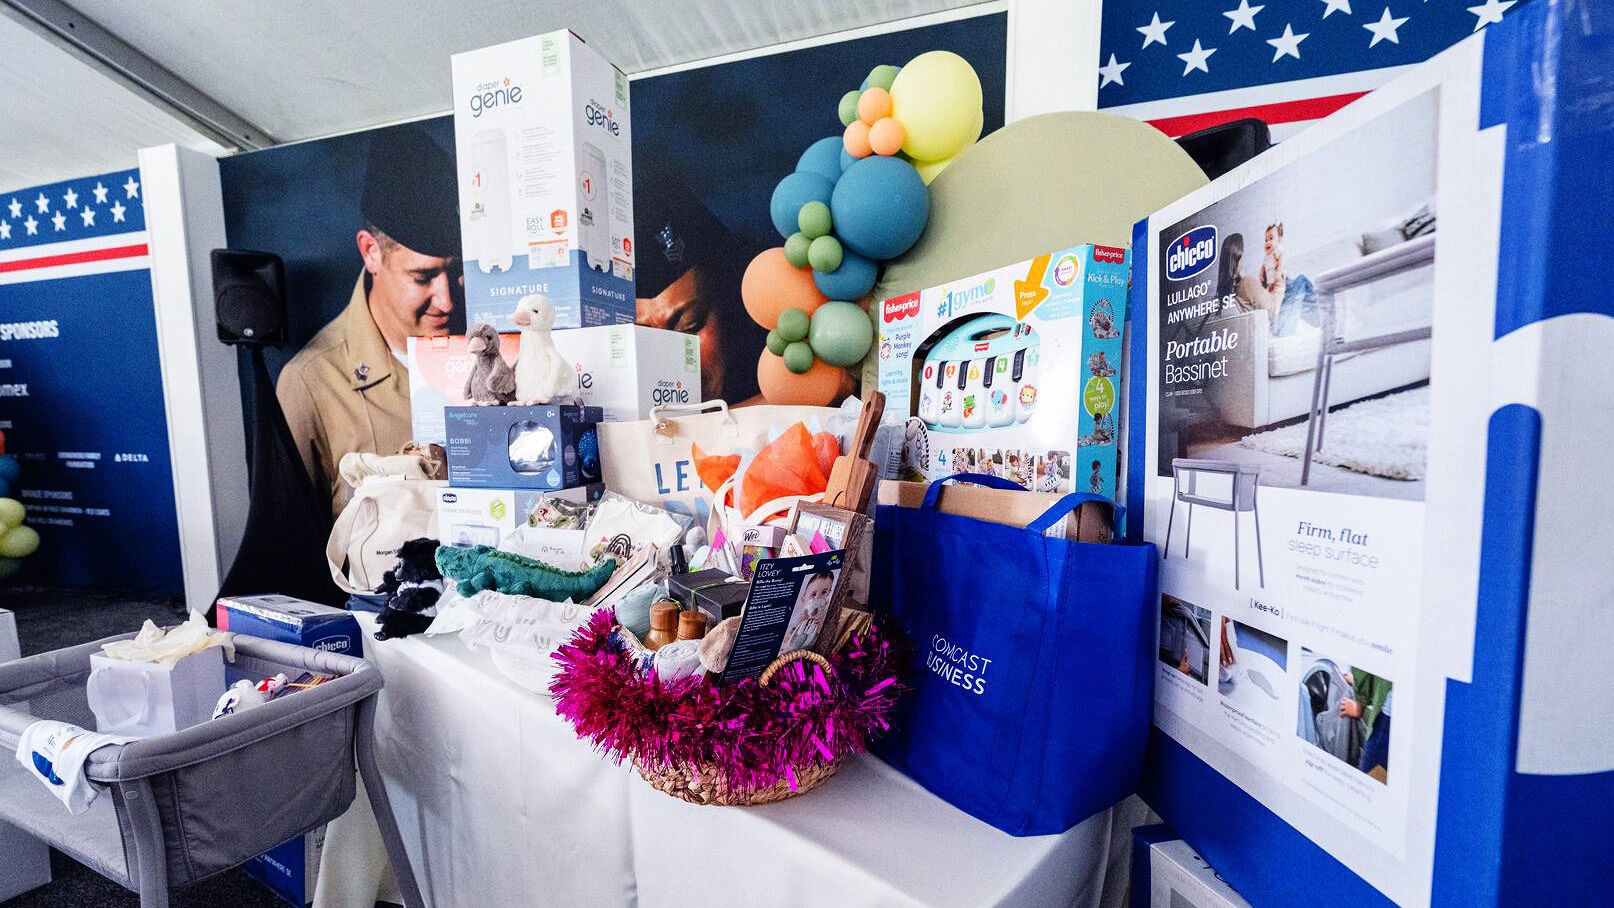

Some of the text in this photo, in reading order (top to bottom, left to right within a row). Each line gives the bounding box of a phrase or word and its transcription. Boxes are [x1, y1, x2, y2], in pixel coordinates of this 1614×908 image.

[470, 86, 523, 118] genie
[585, 104, 620, 137] genie
[1095, 248, 1123, 259] fisher-price
[1169, 236, 1214, 273] chicco
[490, 283, 549, 297] SIGNATURE
[1087, 273, 1104, 283] Kick
[1110, 275, 1125, 288] Play
[591, 285, 626, 301] SIGNATURE
[885, 299, 919, 314] fisher-price
[1167, 293, 1237, 325] ANYWHERE SE
[0, 319, 60, 341] SPONSORS
[1165, 328, 1239, 361] Portable
[1165, 355, 1229, 384] Bassinet
[652, 388, 689, 406] genie
[1095, 379, 1105, 393] 4
[121, 453, 149, 463] DELTA
[744, 531, 758, 541] Wet
[1297, 521, 1369, 547] Firm, flat
[1324, 547, 1379, 569] surface
[315, 639, 348, 652] chicco
[931, 633, 993, 675] COMCAST
[926, 650, 987, 696] BUSINESS
